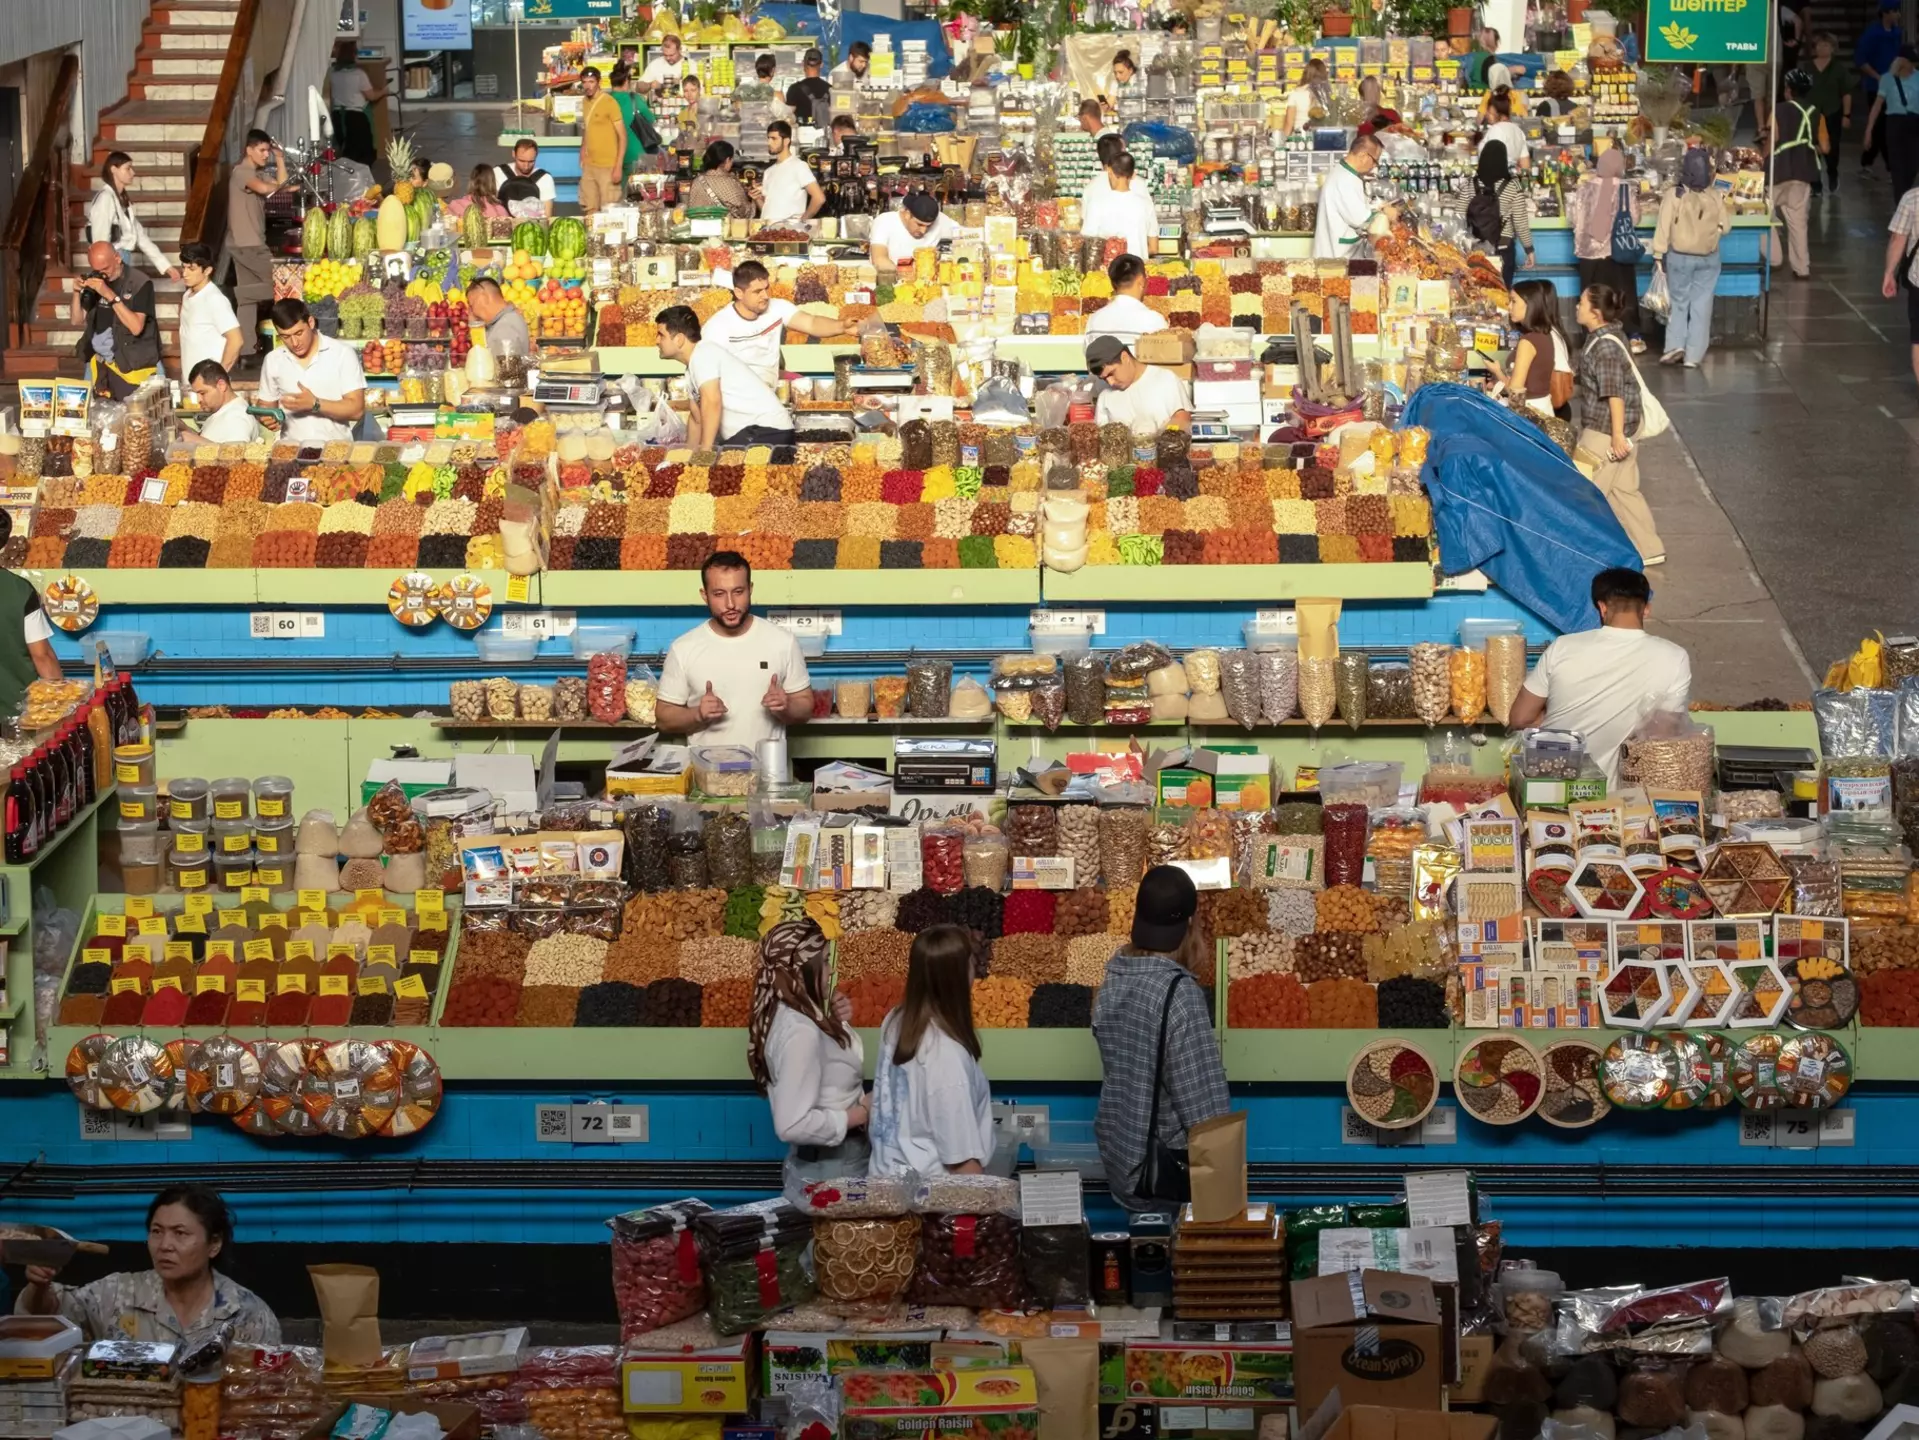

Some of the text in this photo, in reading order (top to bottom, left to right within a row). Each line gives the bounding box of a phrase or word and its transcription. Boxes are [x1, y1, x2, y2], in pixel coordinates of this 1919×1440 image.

[1725, 43, 1758, 51] ТРАВЫ
[1477, 336, 1498, 346] ЧАЙ
[278, 620, 295, 630] 60
[533, 619, 546, 628] 61
[796, 617, 812, 628] 62
[128, 1115, 145, 1128] 71
[581, 1116, 604, 1130] 72
[1785, 1121, 1808, 1134] 75
[1349, 1350, 1415, 1374] Ocean Spray
[1185, 1385, 1255, 1397] Golden Raisin
[897, 1418, 974, 1431] Golden Raisin
